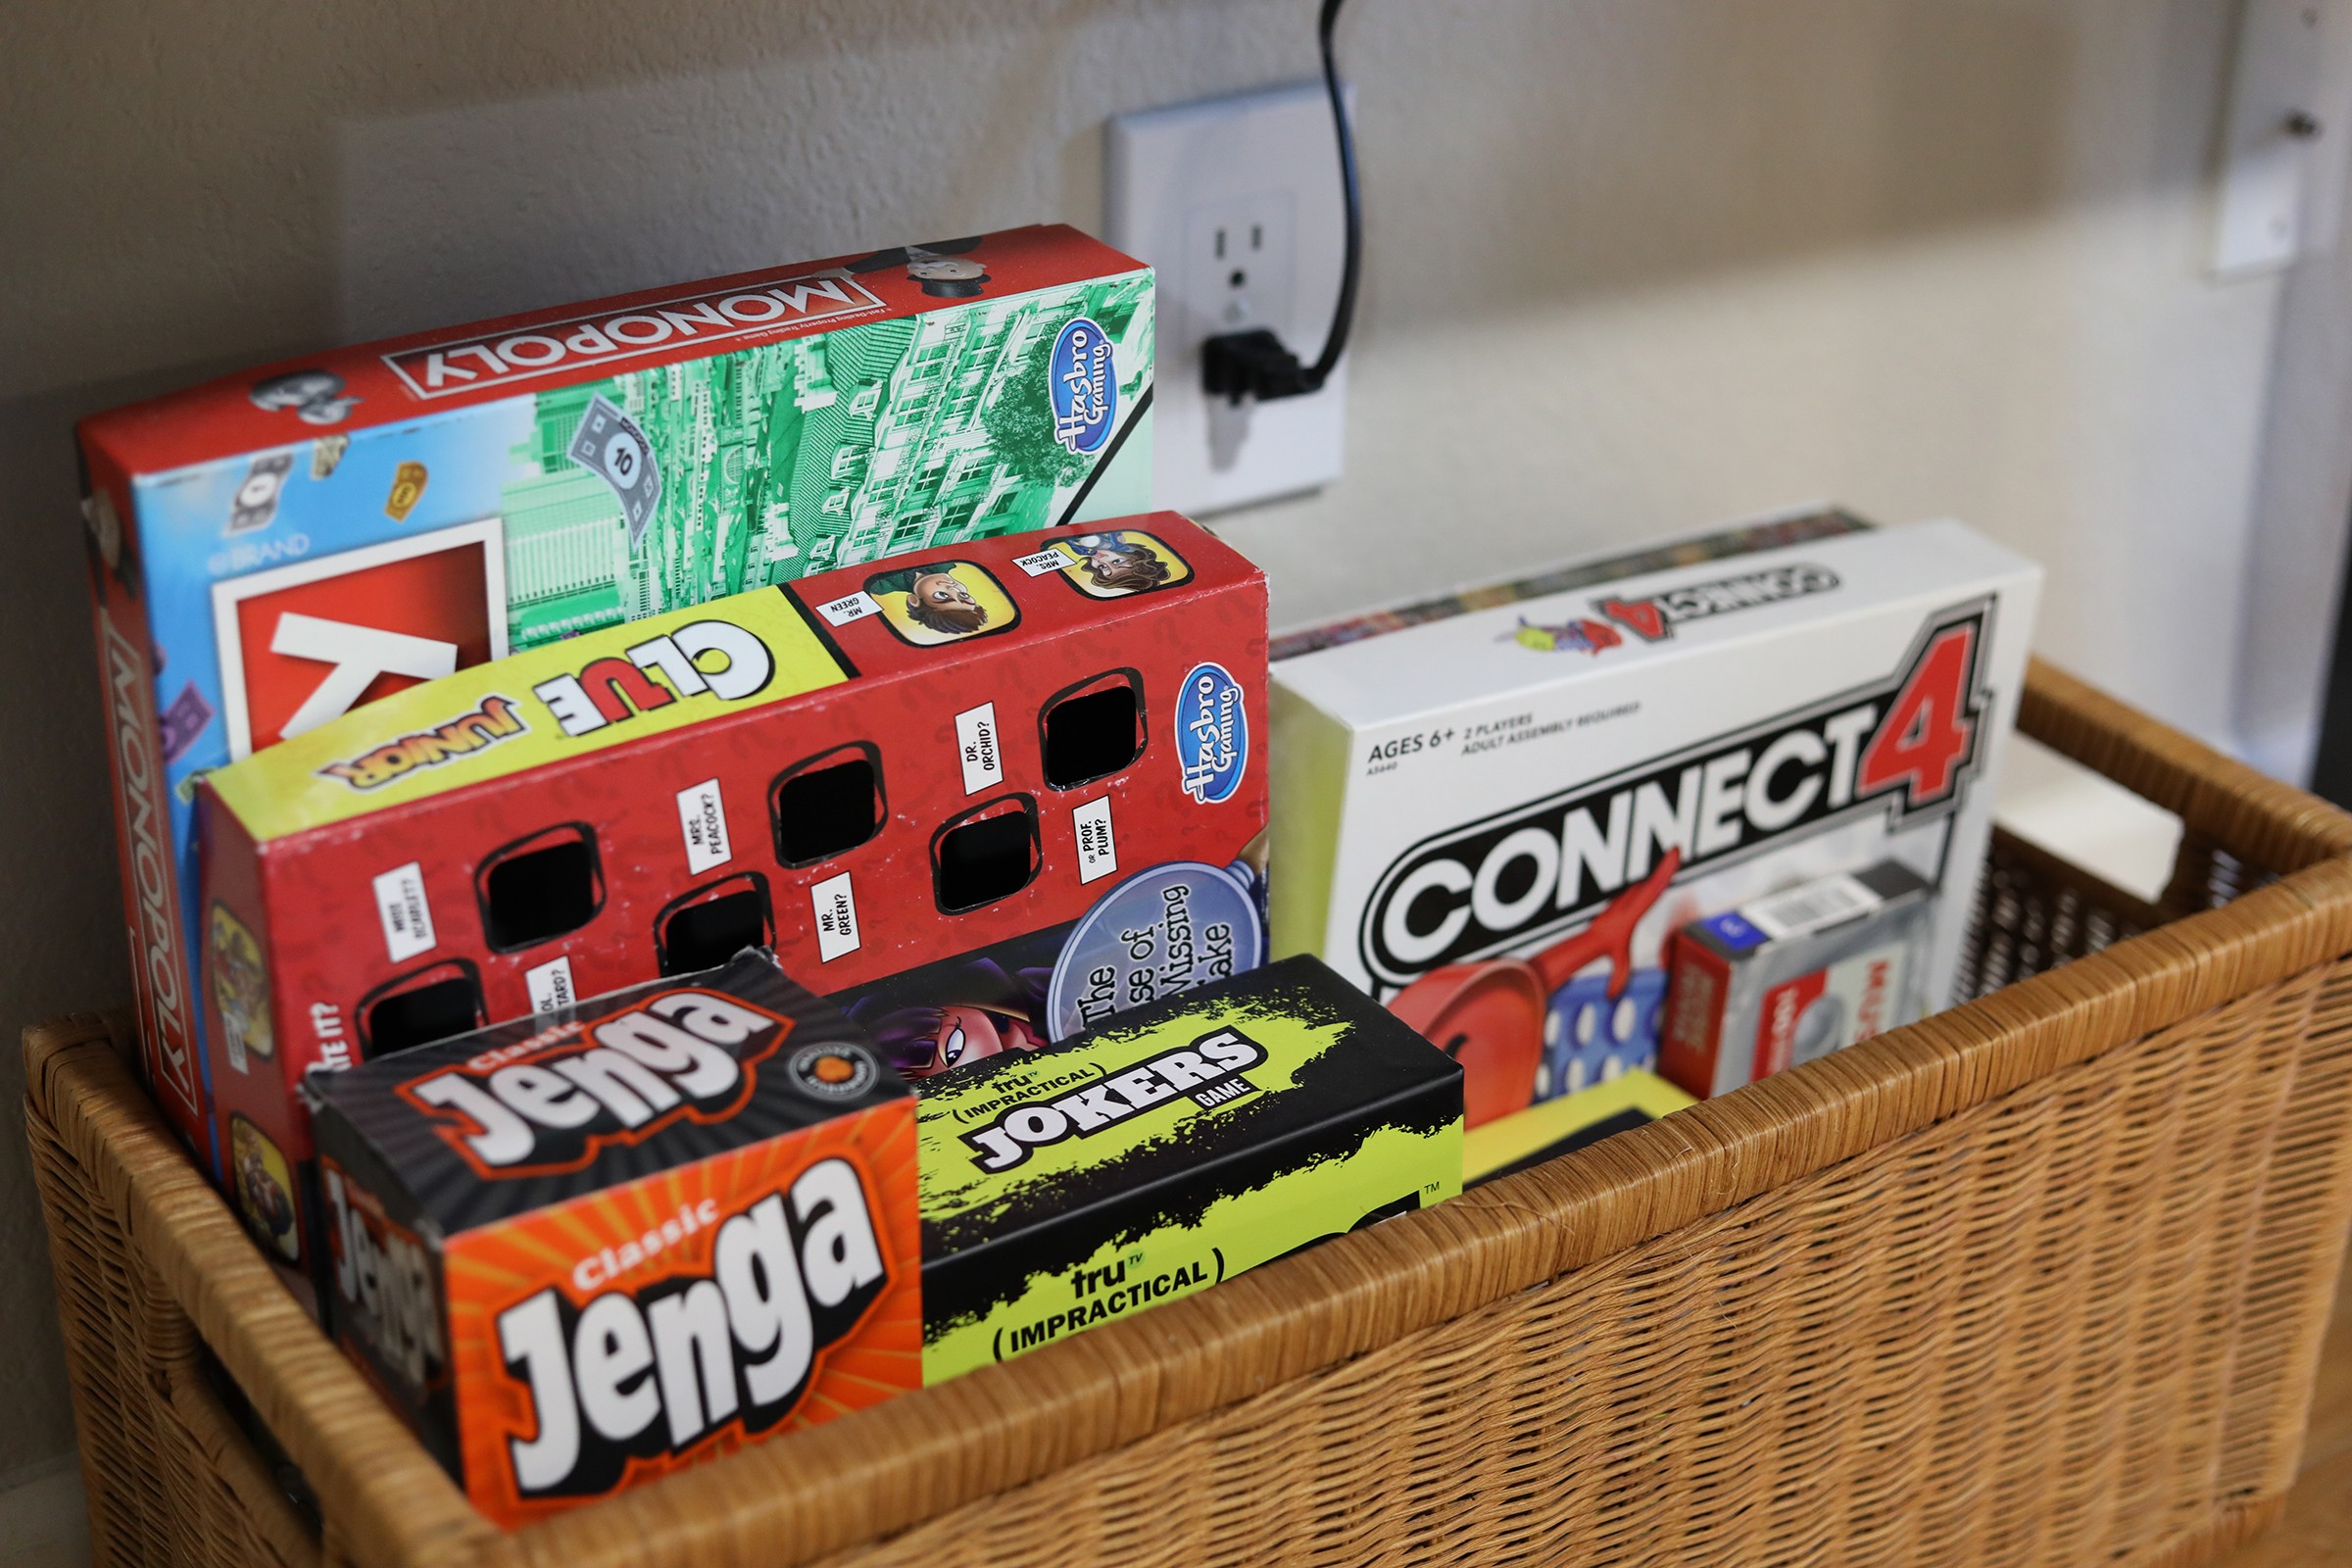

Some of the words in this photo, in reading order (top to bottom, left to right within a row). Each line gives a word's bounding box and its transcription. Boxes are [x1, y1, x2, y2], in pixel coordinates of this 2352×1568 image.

[426, 279, 856, 387] MONOPOLY
[767, 324, 800, 336] Trading
[800, 318, 835, 331] Property
[1058, 329, 1092, 451] Hasbro
[1083, 341, 1111, 425] Gaming
[613, 446, 634, 476] 10
[1020, 549, 1059, 567] PEACOCK
[1034, 559, 1059, 570] MRS.
[830, 596, 860, 612] GREEN
[842, 607, 862, 619] MR.
[532, 619, 776, 738] CLUE
[317, 695, 527, 790] JUNIOR
[1185, 675, 1220, 802] Hasbro
[1211, 686, 1240, 773] Gaming
[1461, 734, 1504, 757] ADULT
[1506, 719, 1573, 745] ASSEMBLY
[1463, 728, 1473, 740] 2
[1475, 711, 1534, 736] PLAYERS
[965, 741, 978, 762] DR.
[977, 721, 995, 770] ORCHID?
[1368, 734, 1424, 763] AGES
[1429, 727, 1455, 749] 6+
[1381, 705, 1876, 964] CONNECT
[1855, 622, 1975, 804] 4
[689, 815, 701, 845] MRS.
[701, 793, 722, 855] PEACOCK?
[1080, 820, 1095, 853] PROF.
[1095, 818, 1109, 857] PLUM?
[108, 648, 190, 1093] MONOPOLY
[821, 908, 835, 932] MR.
[834, 893, 852, 936] GREEN?
[1119, 926, 1155, 960] of
[1198, 923, 1233, 987] ake
[540, 993, 554, 1012] OL.
[552, 969, 569, 1006] TARD?
[310, 1001, 344, 1039] IT?
[467, 1019, 588, 1071] Classic
[413, 992, 776, 1166] Jenga
[1195, 1078, 1251, 1108] GAME
[971, 1032, 1259, 1169] JOKERS
[572, 1198, 720, 1292] Classic
[497, 1157, 885, 1493] Jenga
